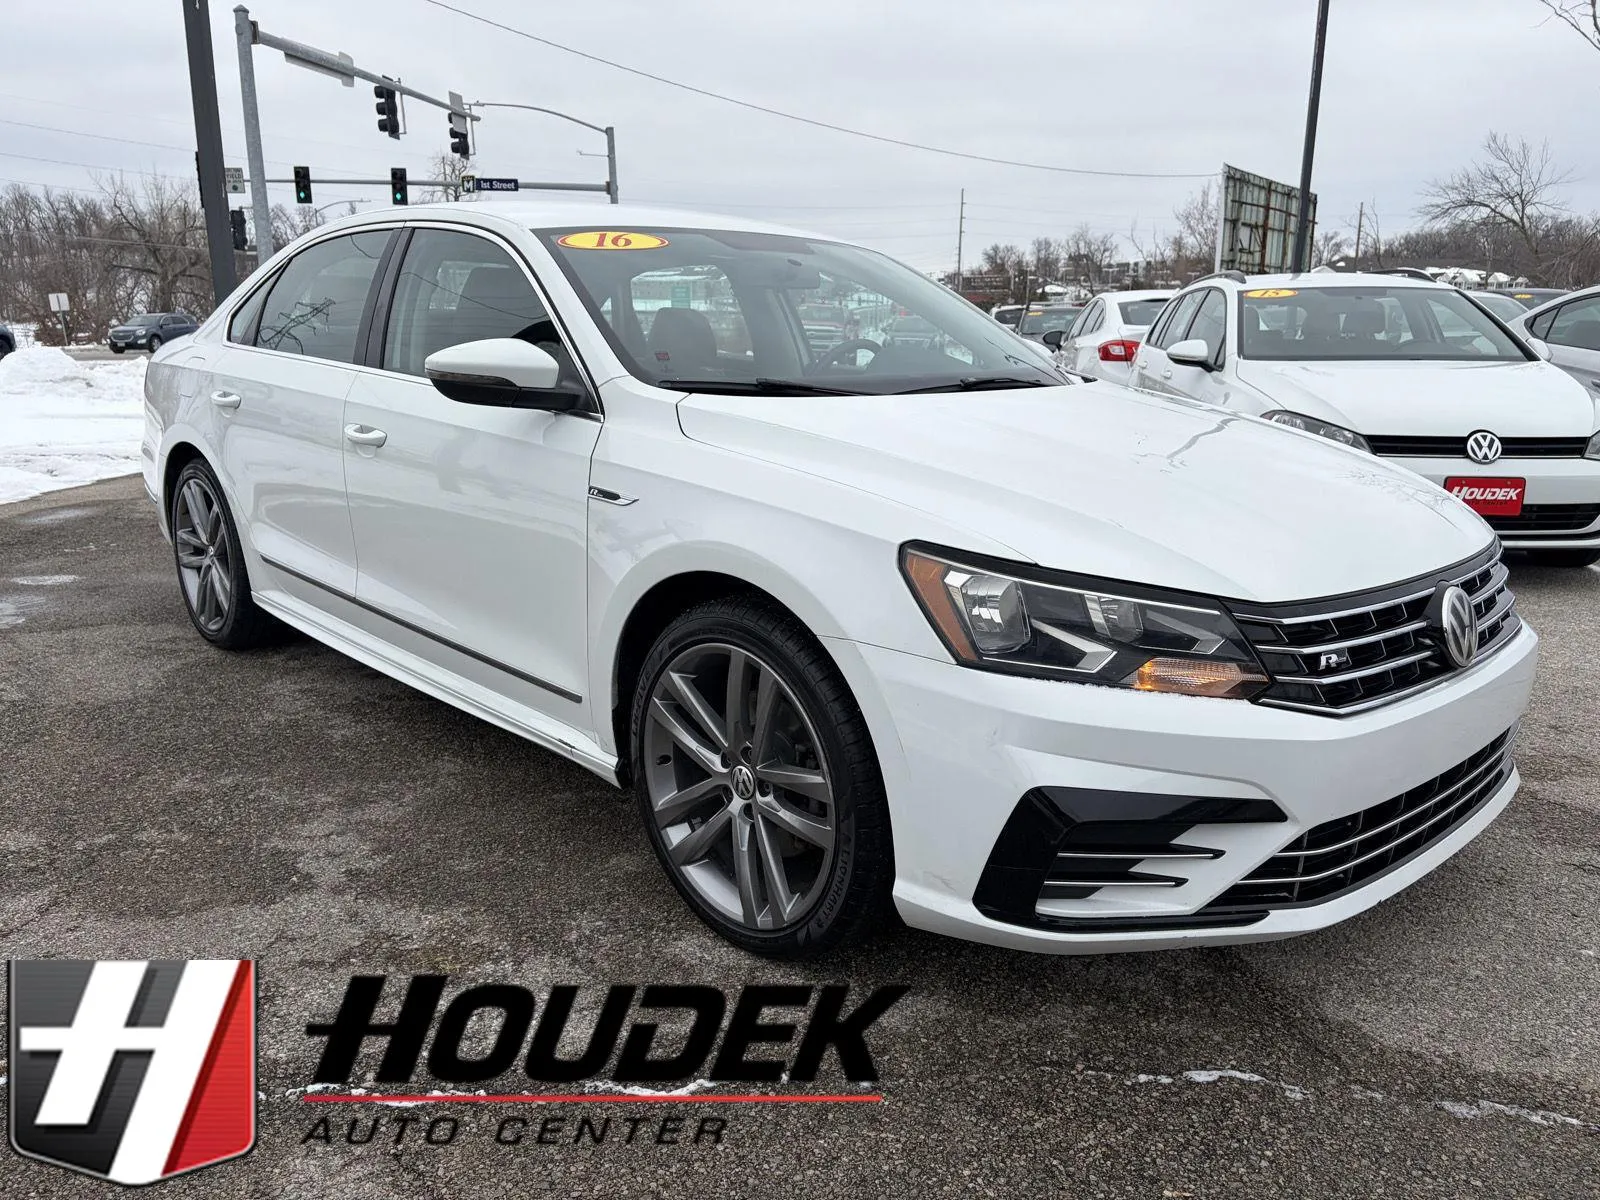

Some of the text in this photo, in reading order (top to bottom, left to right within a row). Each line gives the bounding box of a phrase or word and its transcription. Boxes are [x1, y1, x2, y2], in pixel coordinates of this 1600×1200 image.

[480, 180, 515, 189] 1st Street
[592, 232, 632, 248] 16
[1451, 486, 1523, 501] HOUDEK
